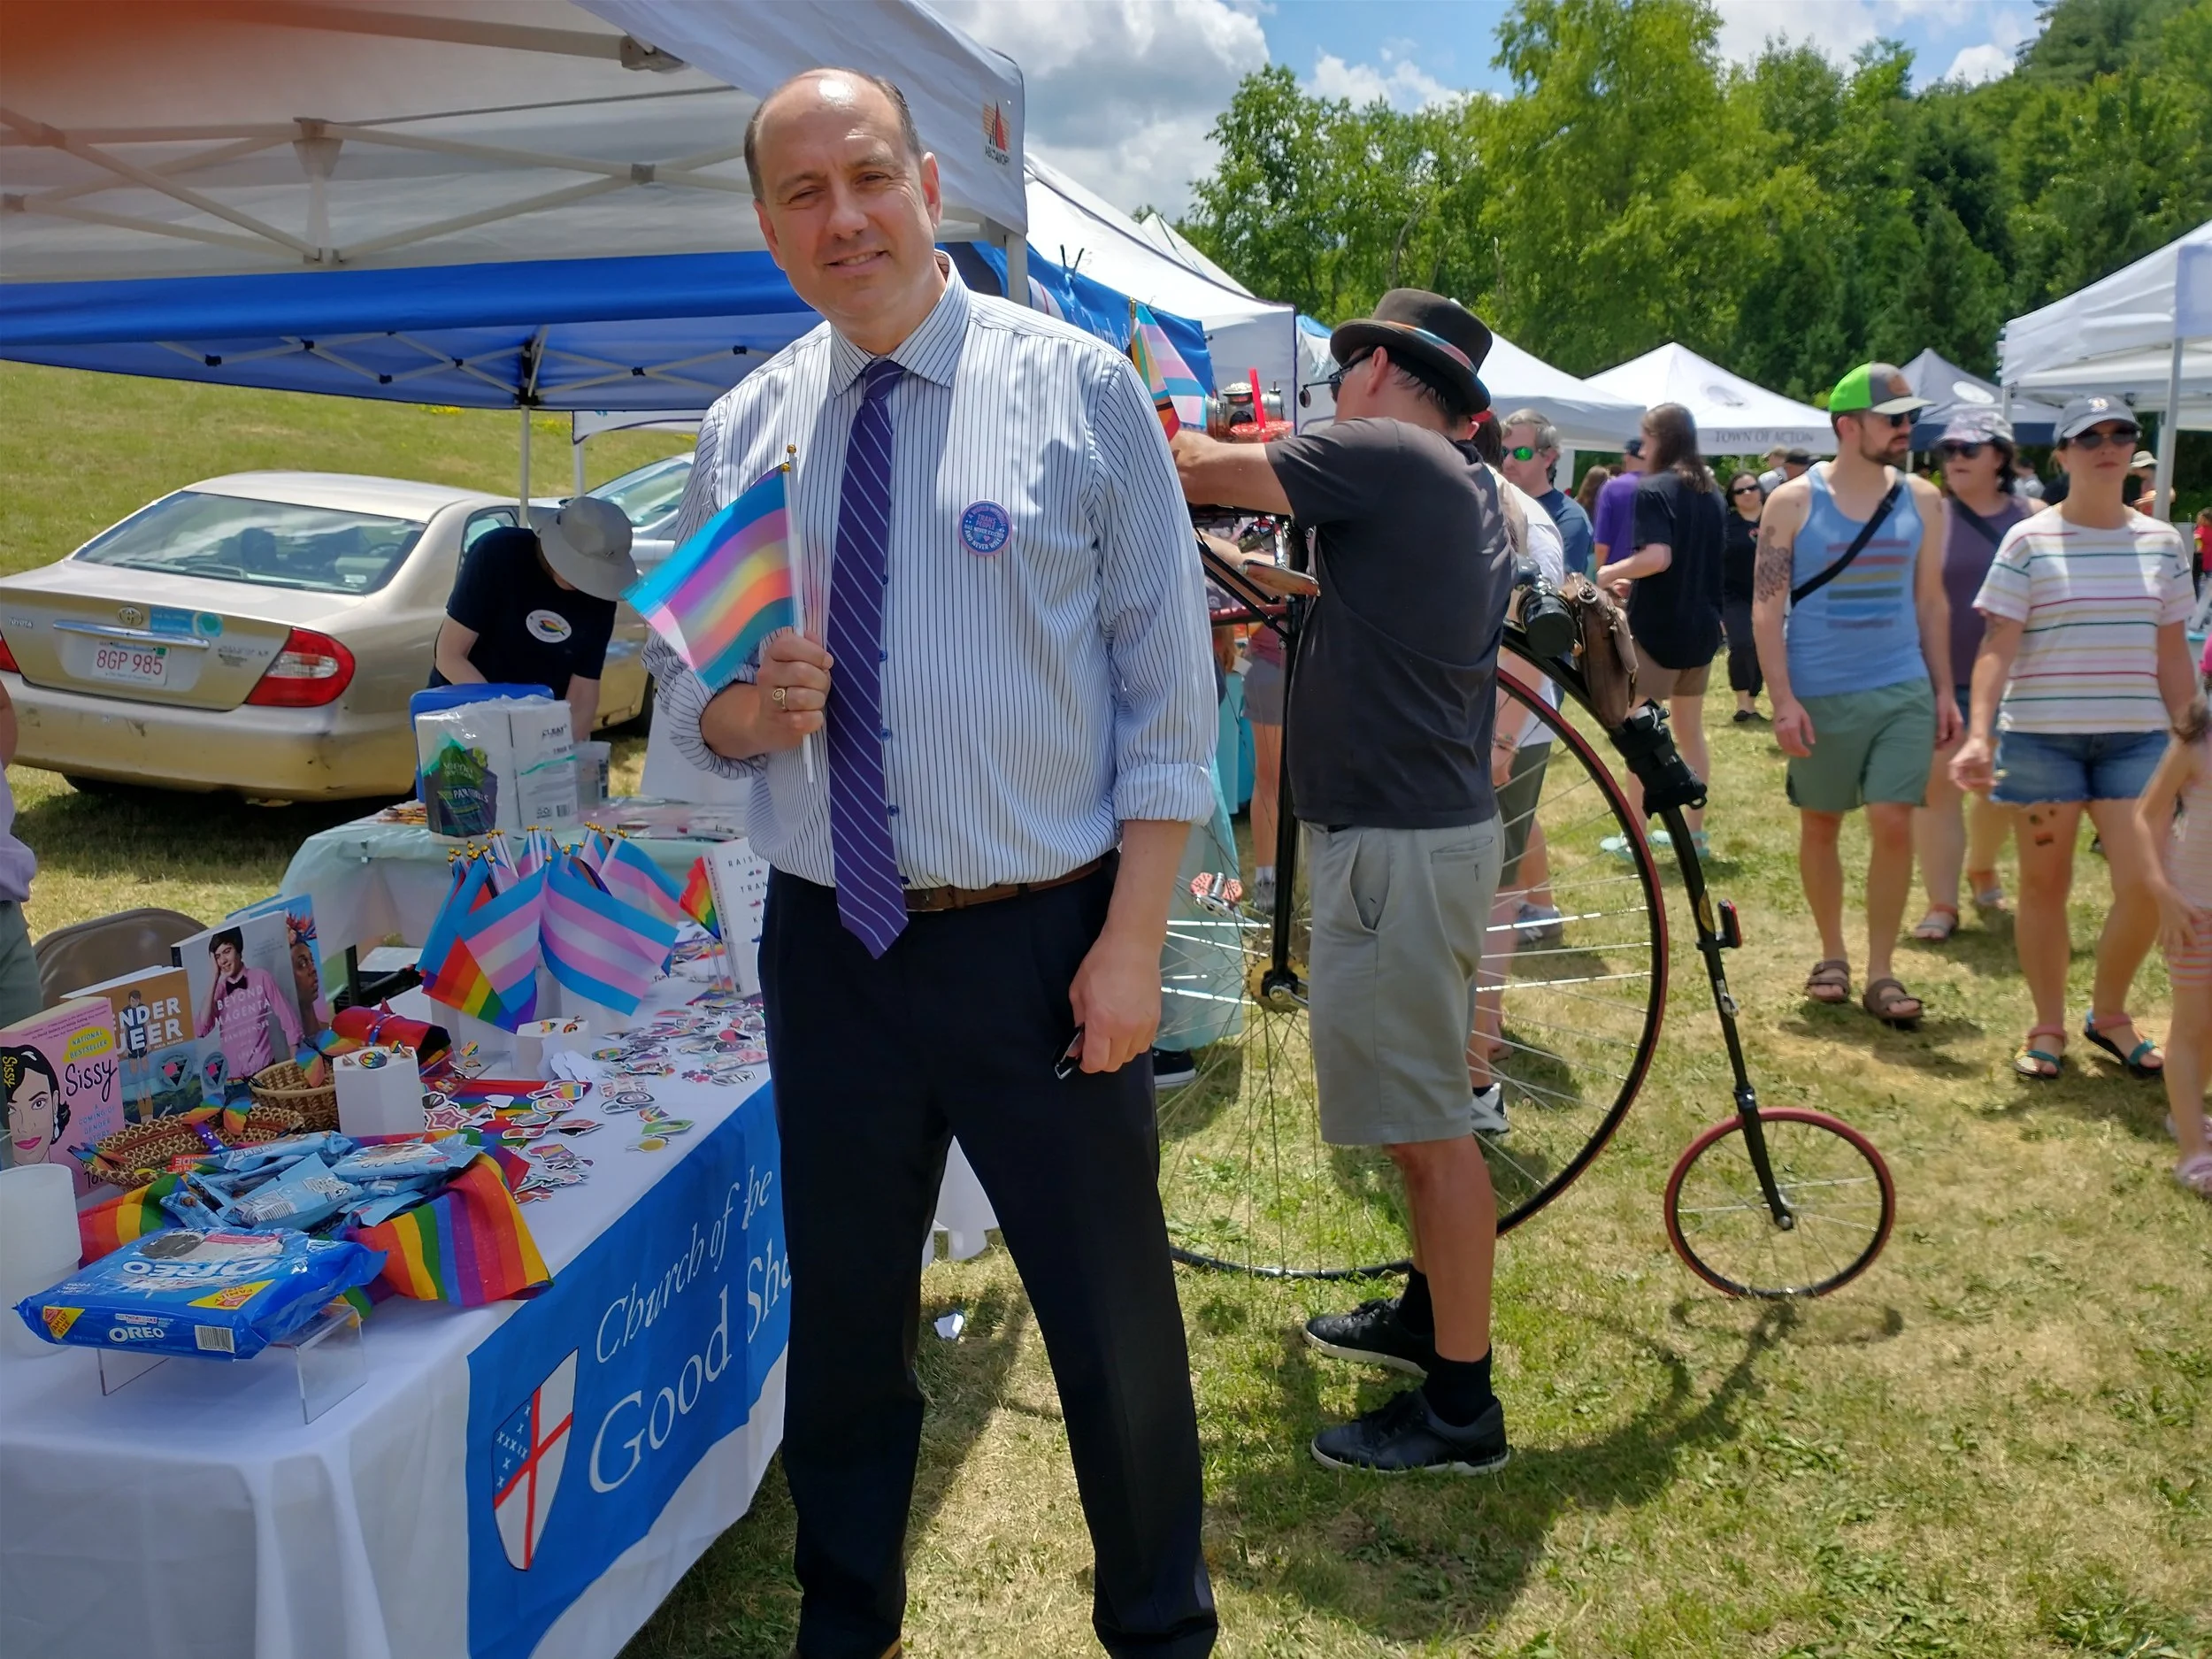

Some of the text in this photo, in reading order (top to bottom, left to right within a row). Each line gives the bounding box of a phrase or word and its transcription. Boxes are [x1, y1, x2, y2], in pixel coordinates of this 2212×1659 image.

[1715, 430, 1814, 442] TOWN OF ACTON
[96, 649, 128, 671] 8GP
[132, 653, 165, 676] 985
[217, 985, 264, 1010] BEYOND
[113, 997, 181, 1031] NDER
[215, 999, 272, 1025] MAGENTA
[69, 1040, 108, 1059] BESTSELLER
[72, 1031, 104, 1046] NATIONAL
[65, 1059, 119, 1102] Sissy
[121, 1257, 278, 1280] OREO
[595, 1222, 704, 1364] Church
[709, 1182, 741, 1271] of
[109, 1326, 165, 1343] OREO
[588, 1285, 733, 1494] Good
